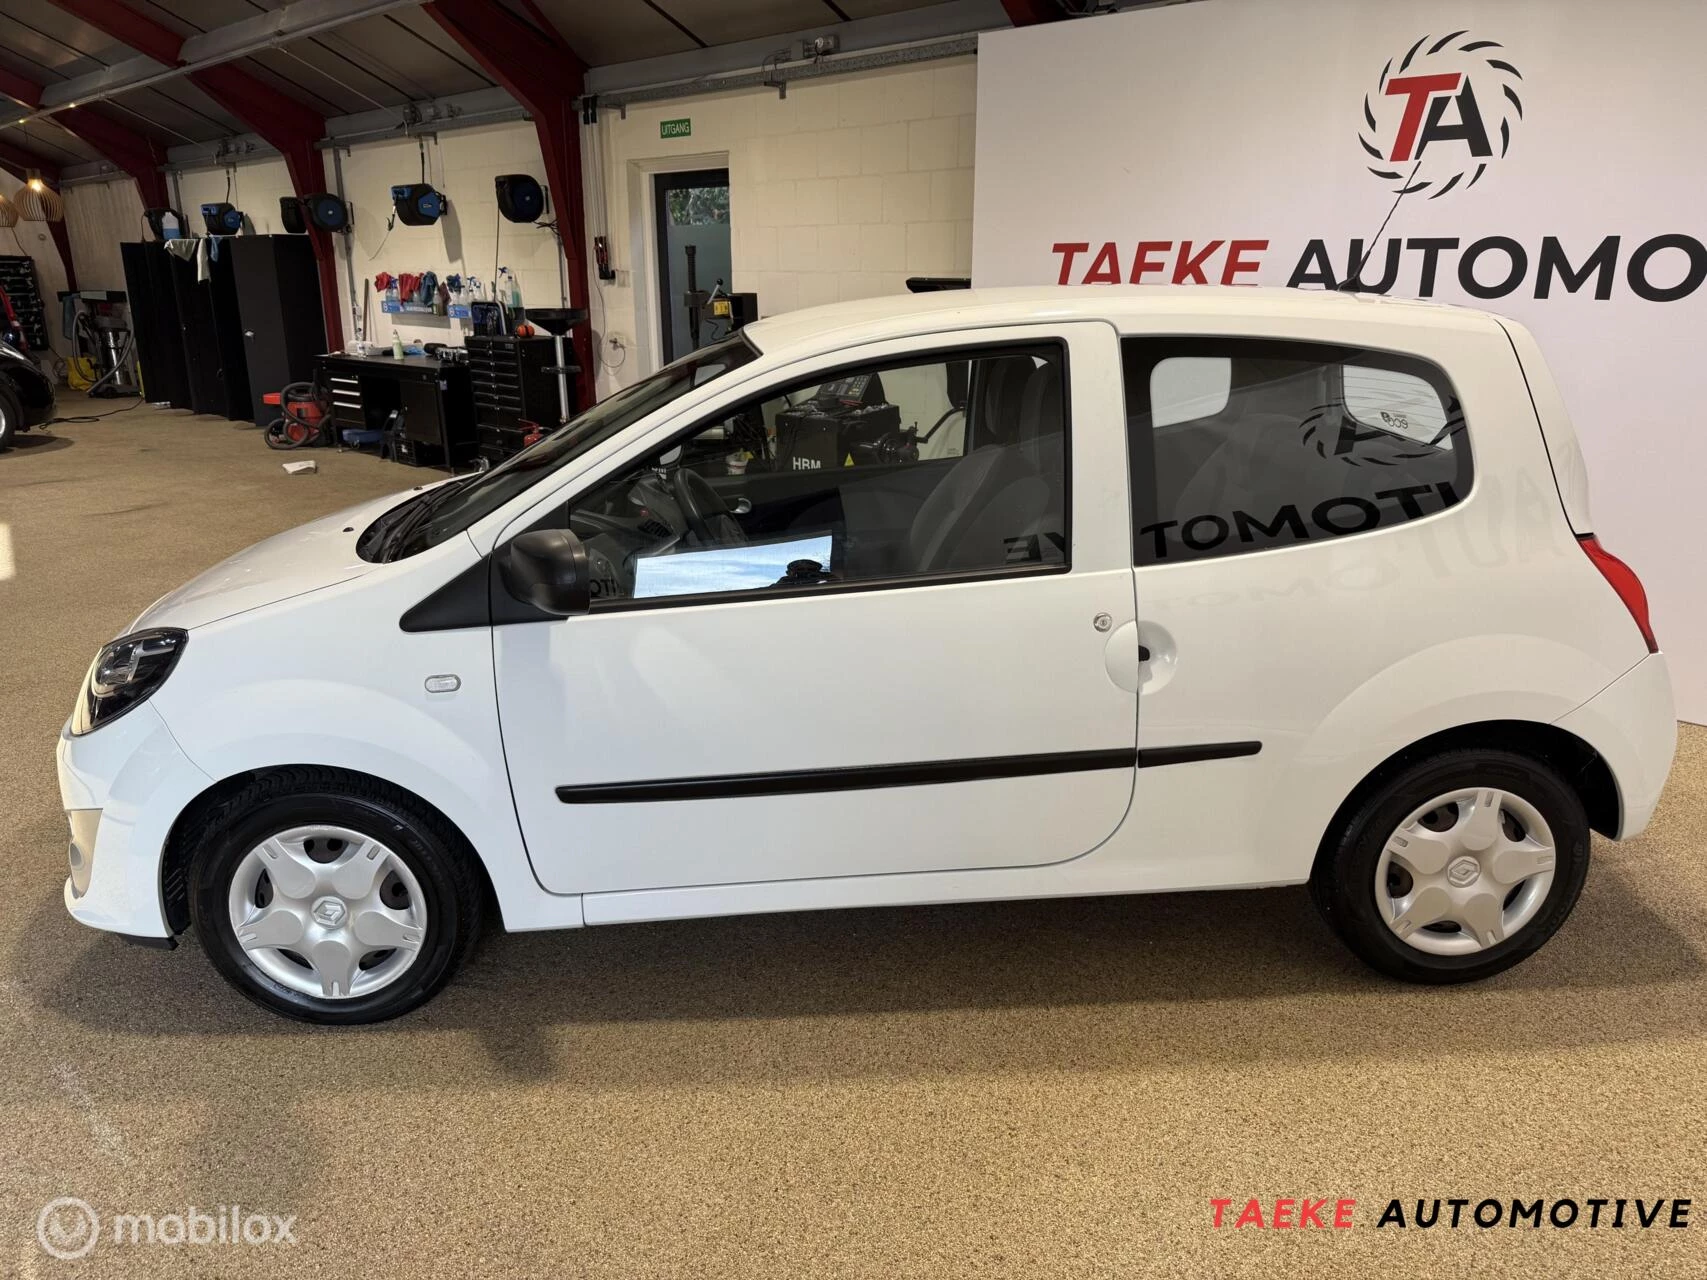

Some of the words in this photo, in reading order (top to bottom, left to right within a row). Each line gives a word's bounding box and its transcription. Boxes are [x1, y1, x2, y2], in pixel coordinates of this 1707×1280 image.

[661, 121, 690, 136] UITGANG
[1385, 72, 1493, 162] TA
[1052, 240, 1269, 286] TAEKE
